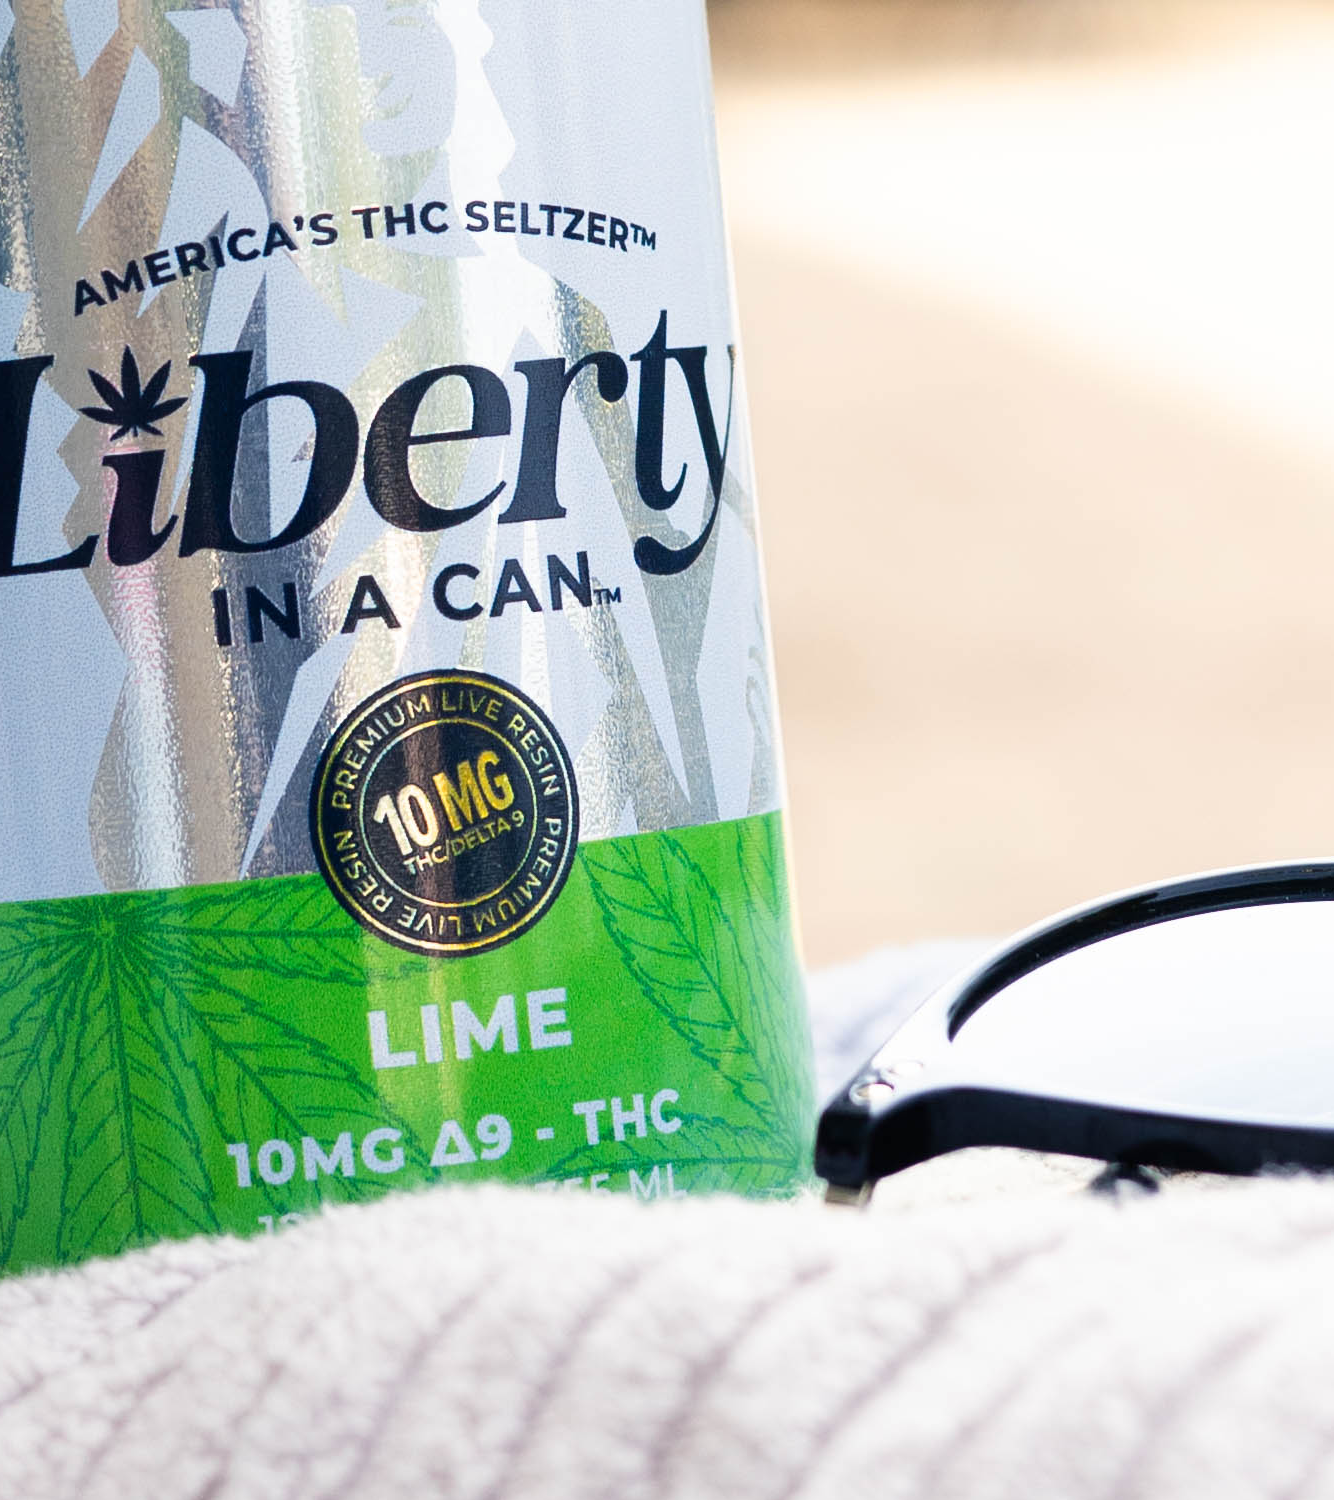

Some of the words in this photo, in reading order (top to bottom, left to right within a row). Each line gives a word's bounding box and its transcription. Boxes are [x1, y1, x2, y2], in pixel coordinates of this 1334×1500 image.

[72, 212, 338, 318] AMERICA’S
[351, 201, 451, 243] THC
[212, 573, 301, 648] IN
[340, 574, 402, 636] A
[331, 693, 432, 810] PREMIUM
[441, 688, 504, 721] LIVE
[507, 713, 562, 798] RESIN
[373, 783, 440, 857] 10
[432, 750, 515, 833] MG
[402, 817, 512, 875] THC/DELTA
[511, 809, 525, 828] 9
[333, 828, 395, 914] RESIN
[473, 816, 562, 934] PREMIUM
[396, 903, 462, 937] LIVE
[367, 986, 572, 1071] LIME
[226, 1126, 406, 1188] 10MG
[572, 1087, 683, 1146] THC
